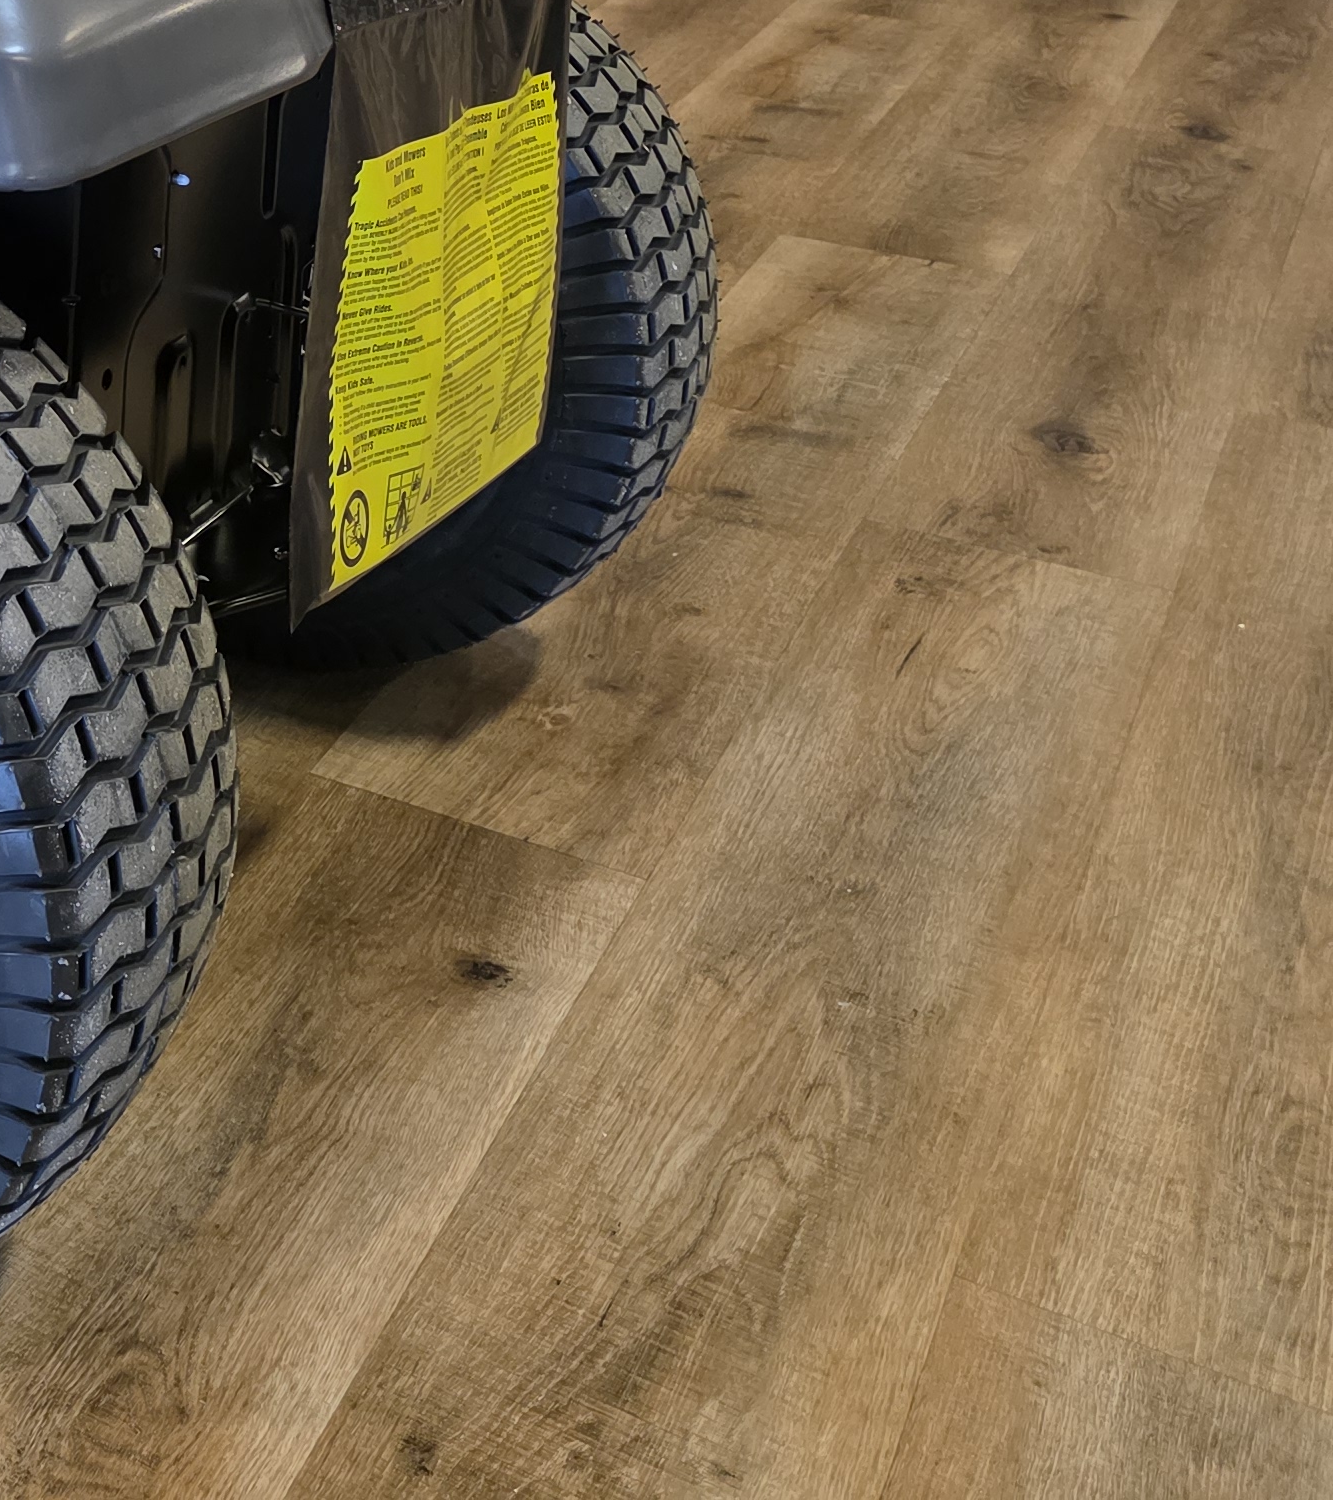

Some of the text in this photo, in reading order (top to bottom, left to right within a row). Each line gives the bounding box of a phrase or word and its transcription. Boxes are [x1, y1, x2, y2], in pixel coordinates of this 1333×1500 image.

[541, 80, 550, 92] de
[530, 98, 546, 112] Bien
[497, 107, 507, 120] Los
[403, 147, 426, 164] Mowers
[355, 220, 375, 232] Tragic
[359, 308, 373, 317] Give
[373, 304, 393, 315] Rides.
[347, 346, 371, 359] Extreme
[372, 342, 395, 353] Caution
[347, 380, 358, 391] Kids
[359, 376, 374, 387] Safe.
[369, 424, 395, 439] MOWERS
[395, 420, 407, 432] ARE
